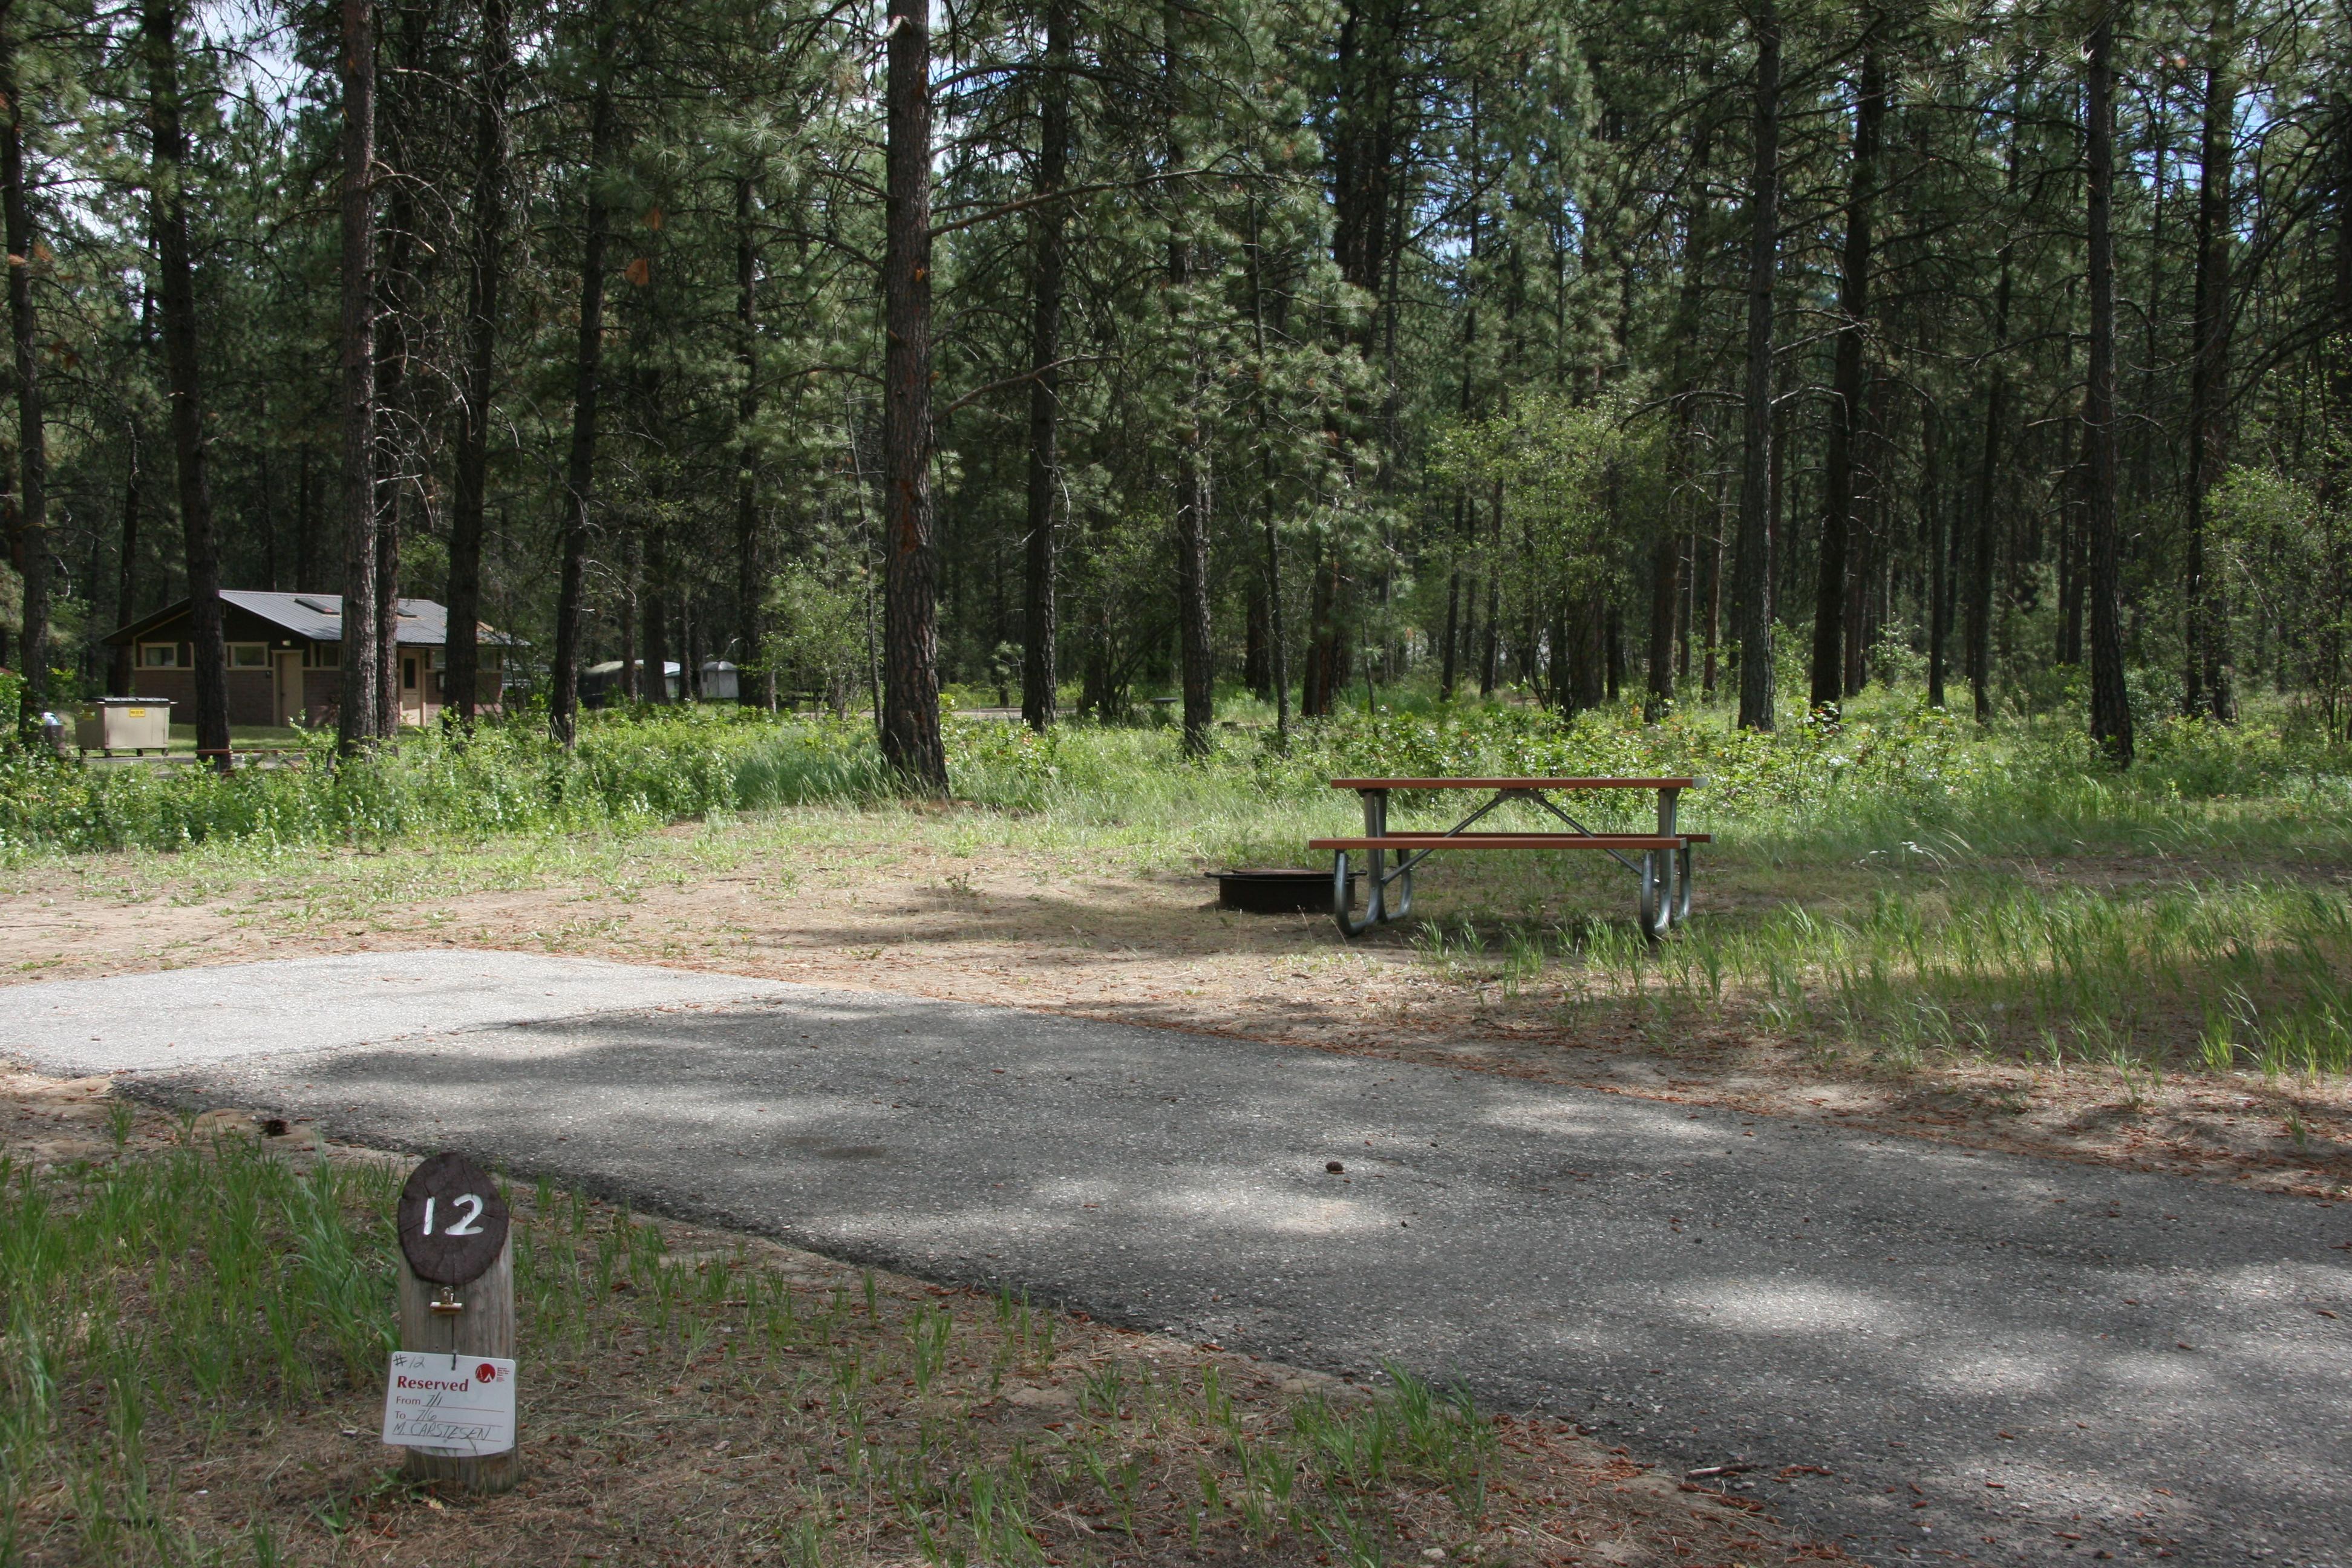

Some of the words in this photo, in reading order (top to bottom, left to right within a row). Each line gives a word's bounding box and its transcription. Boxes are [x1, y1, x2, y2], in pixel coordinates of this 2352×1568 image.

[423, 1193, 485, 1235] 12
[397, 1375, 469, 1393] Reserved
[396, 1396, 421, 1405] From
[395, 1411, 407, 1419] To
